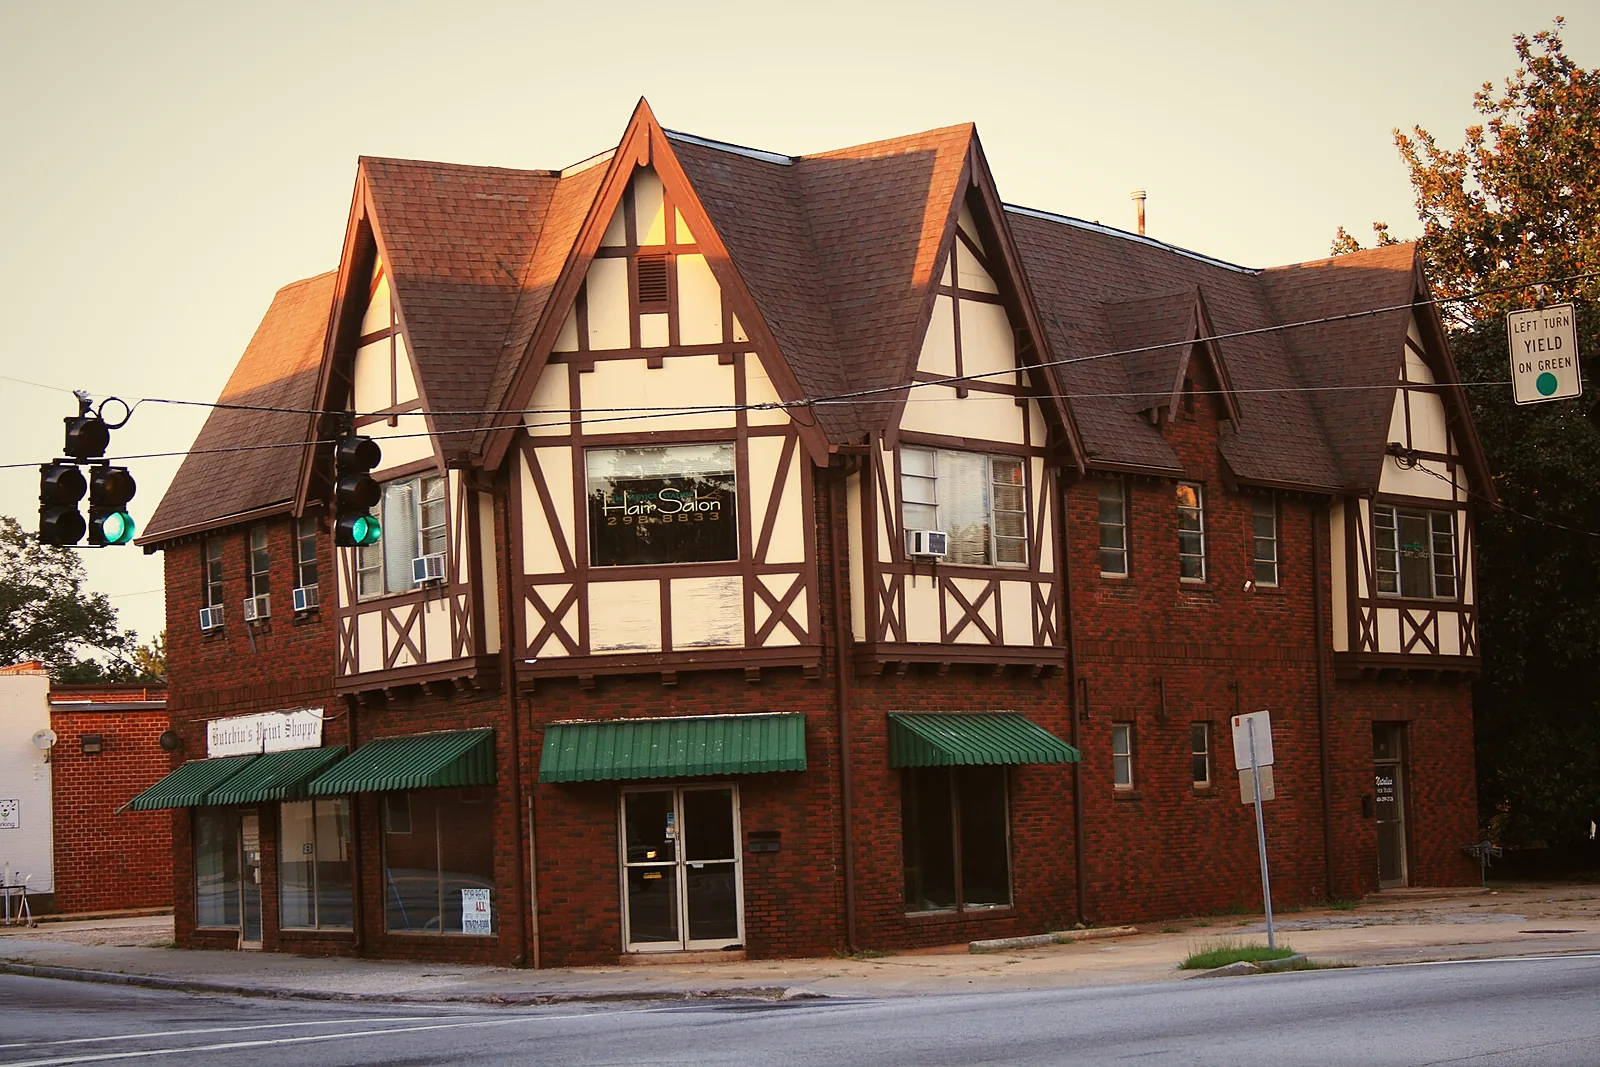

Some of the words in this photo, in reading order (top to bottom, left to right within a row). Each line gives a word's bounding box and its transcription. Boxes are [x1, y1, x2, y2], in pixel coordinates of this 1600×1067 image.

[1514, 320, 1537, 334] LEFT
[1543, 315, 1570, 329] TURN
[1524, 336, 1562, 354] YIELD
[1518, 361, 1532, 374] ON
[1538, 356, 1572, 371] GREEN
[602, 489, 657, 516] Hair
[657, 487, 721, 514] Salon
[256, 721, 281, 745] Print
[285, 718, 318, 740] Shoppe
[303, 844, 312, 853] 8
[464, 889, 475, 900] FOR
[475, 888, 489, 901] RENT
[476, 901, 486, 912] ALL
